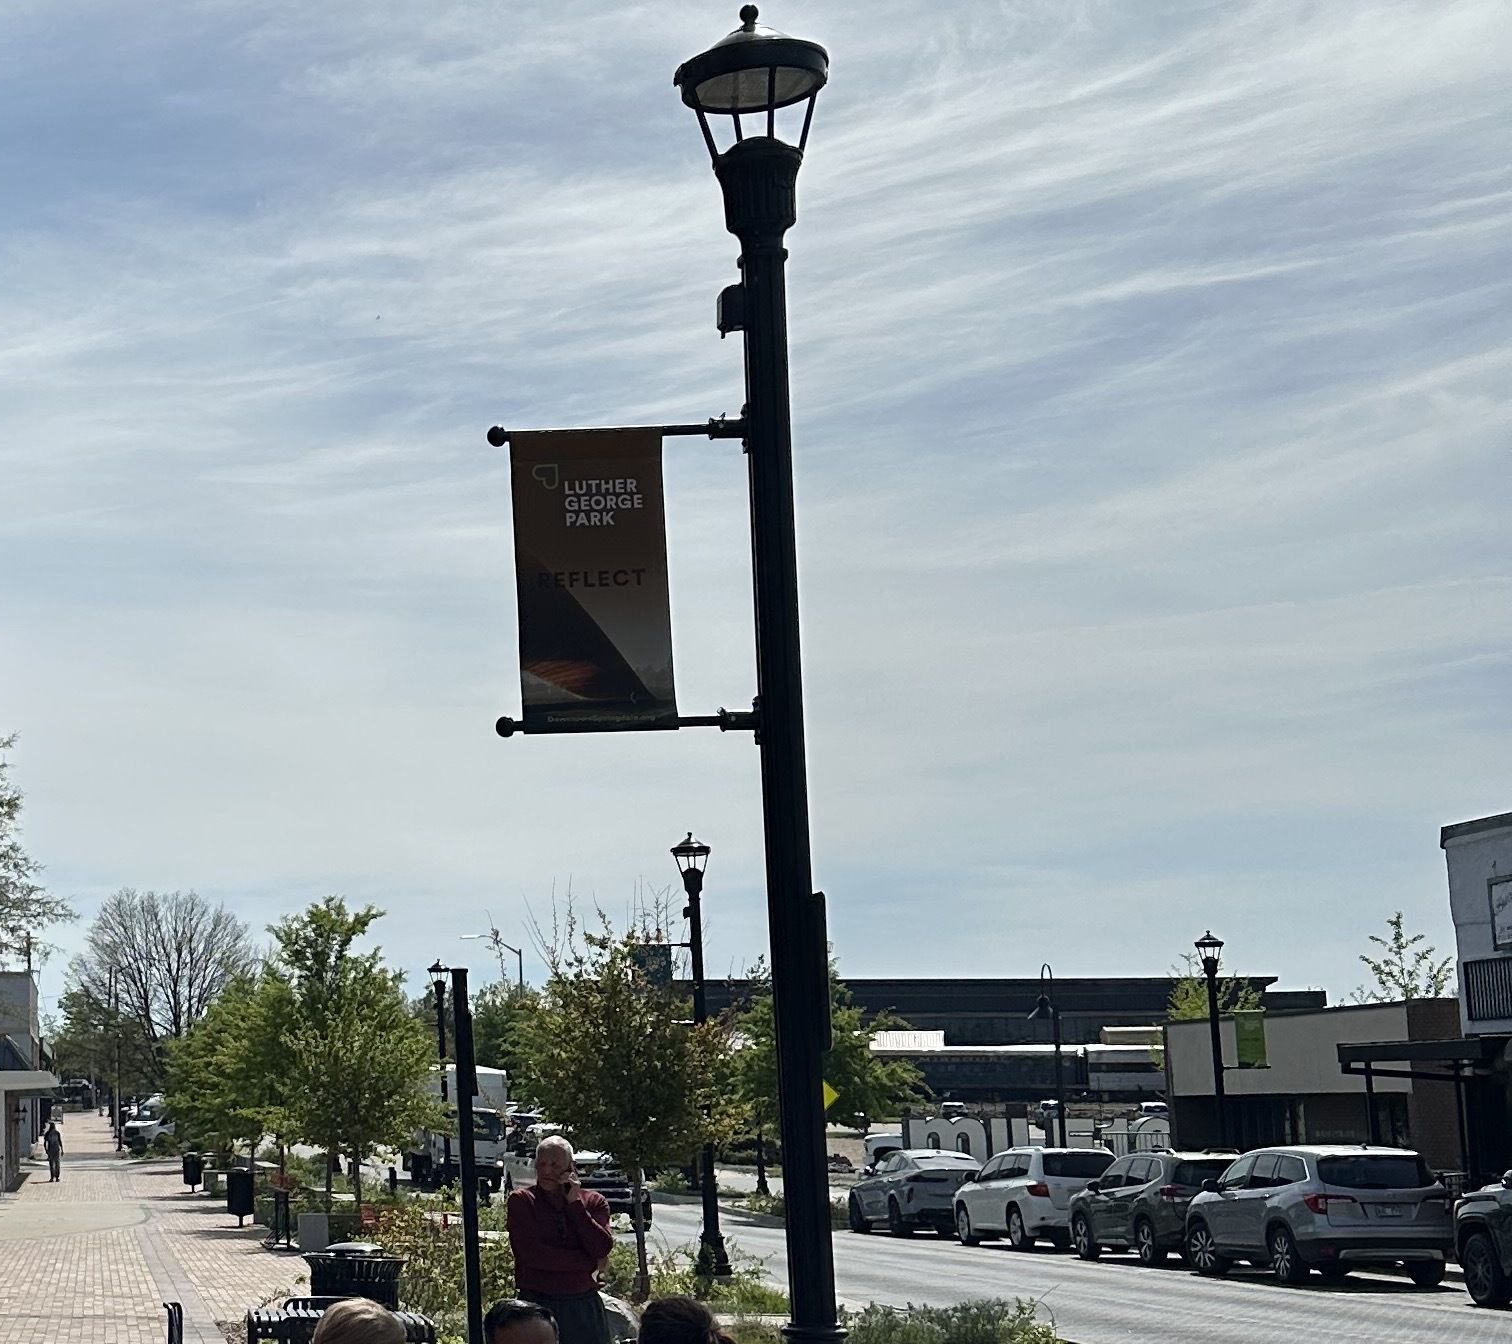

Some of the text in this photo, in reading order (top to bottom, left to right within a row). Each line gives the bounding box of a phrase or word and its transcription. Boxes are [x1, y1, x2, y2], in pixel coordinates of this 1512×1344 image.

[564, 478, 638, 495] LUTHER
[564, 494, 644, 511] GEORGE
[565, 511, 616, 527] PARK
[538, 568, 646, 588] REFLECT
